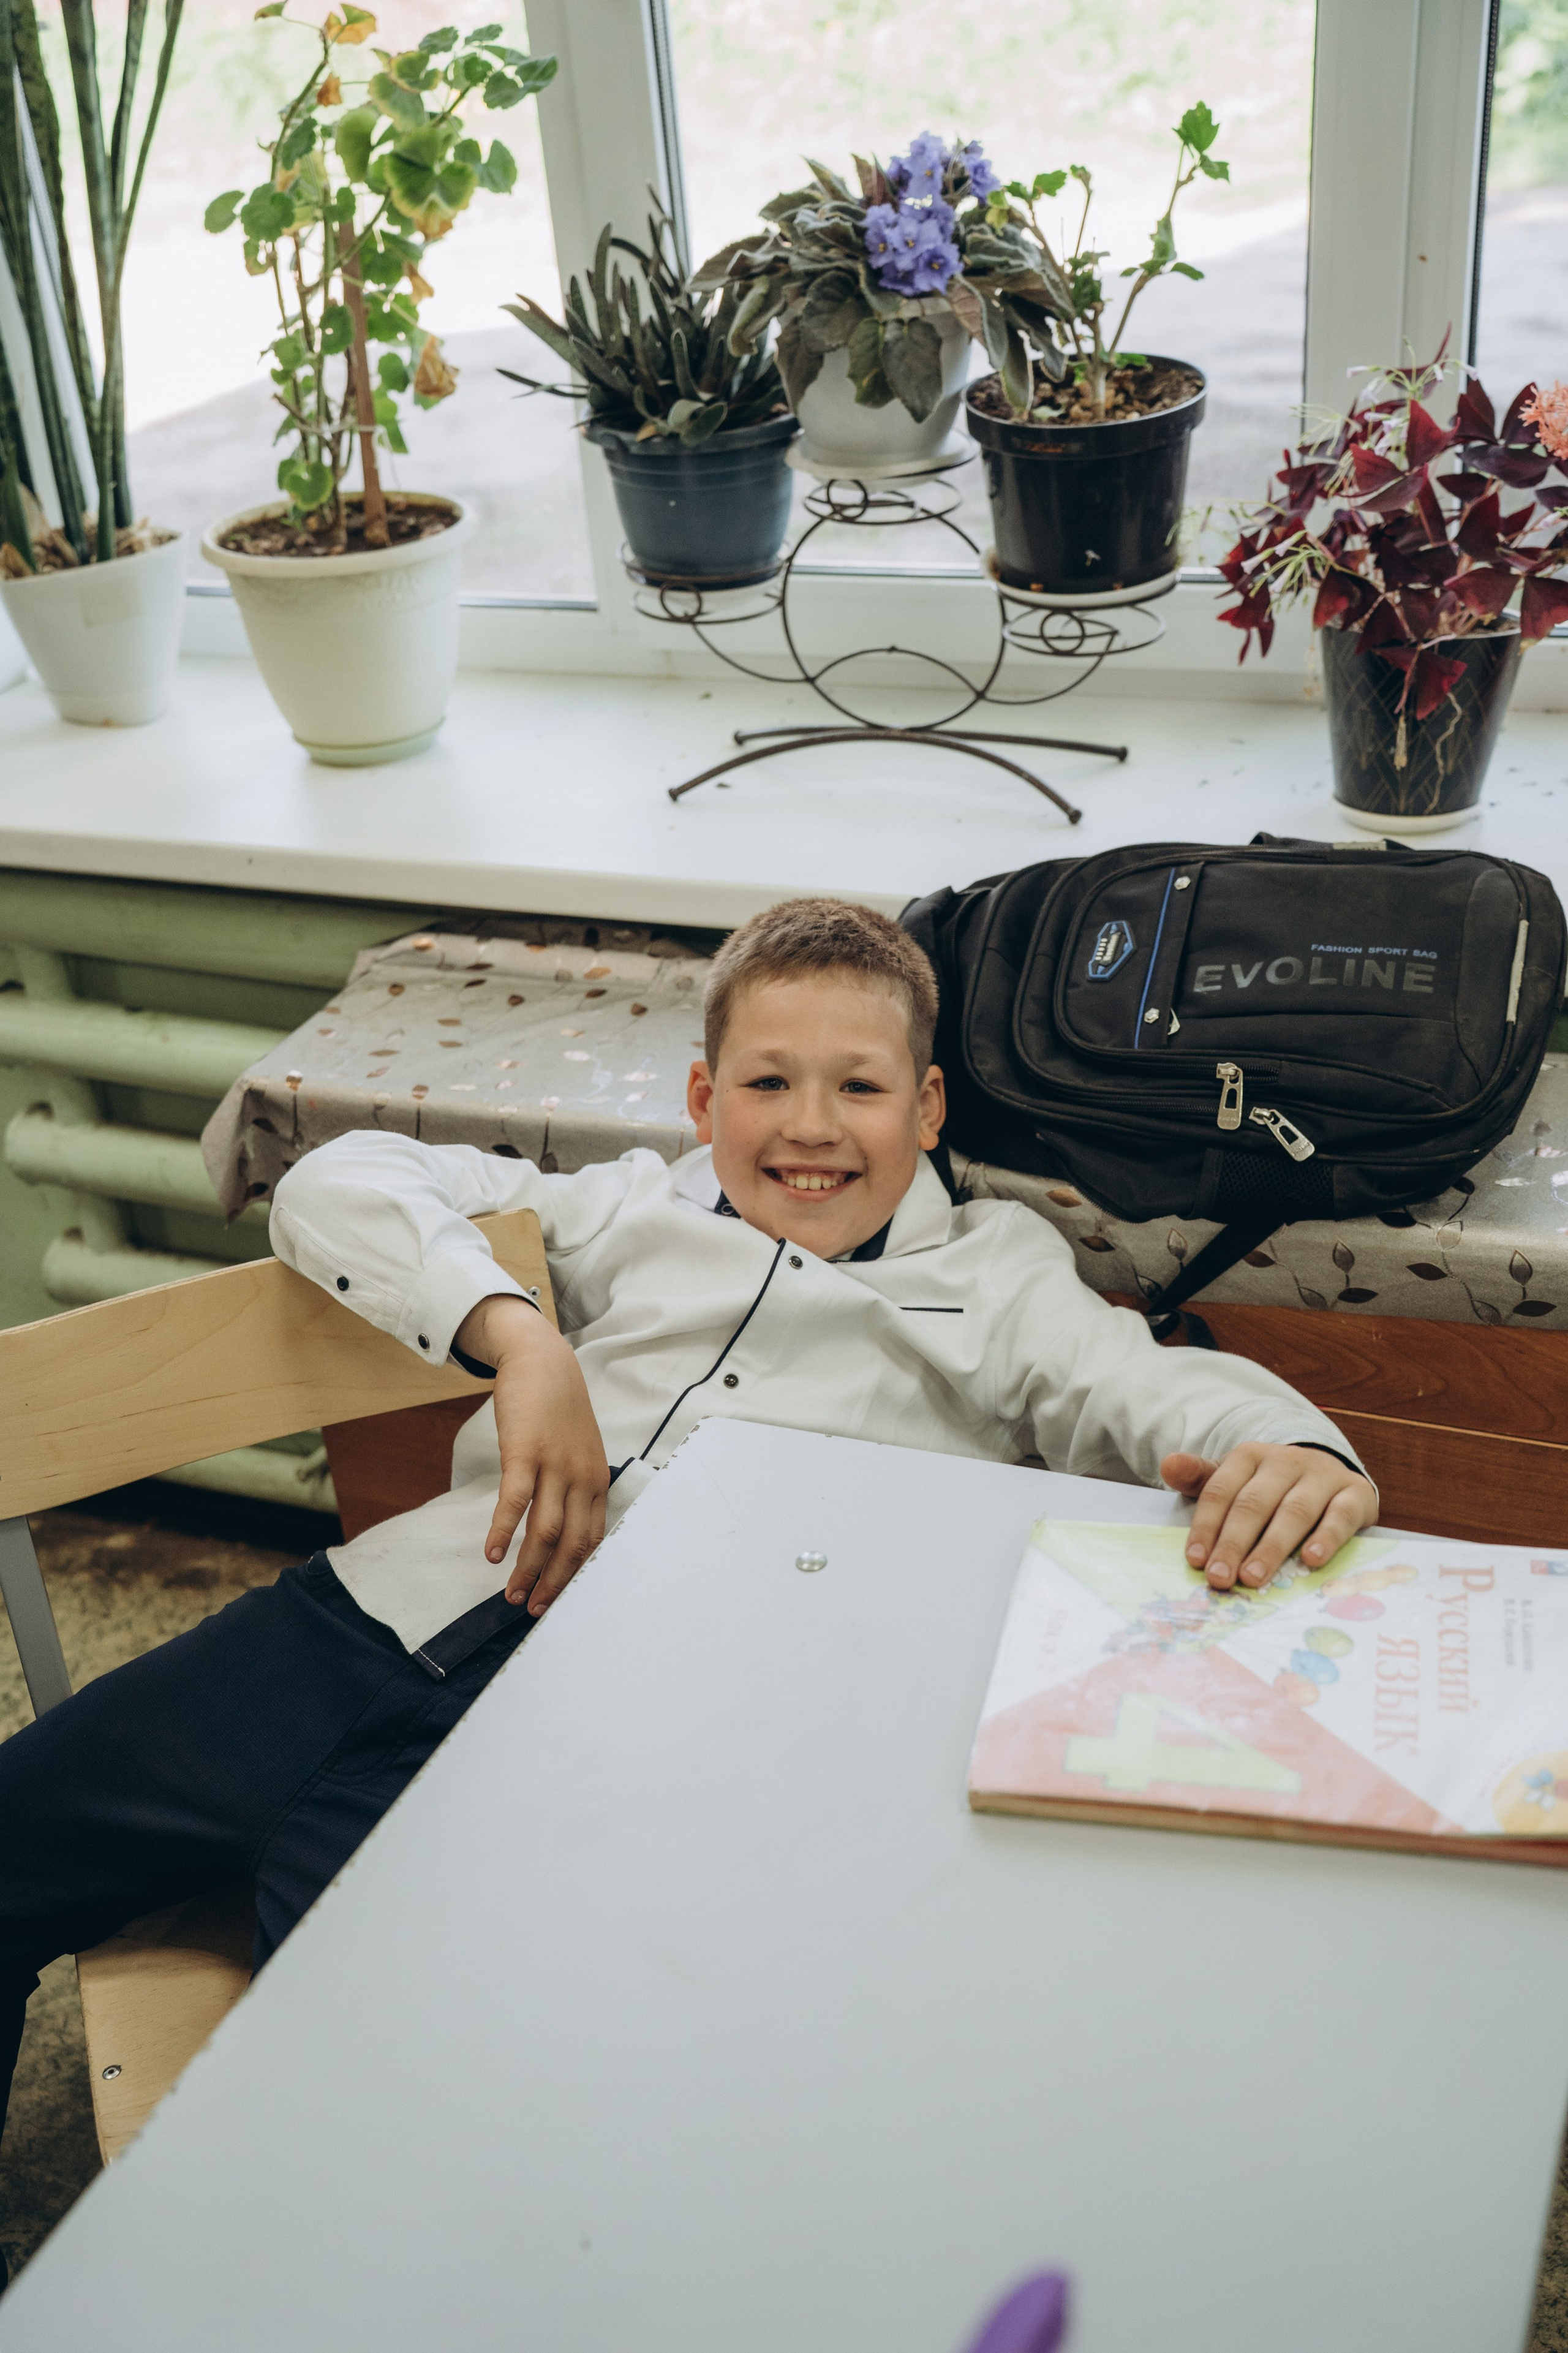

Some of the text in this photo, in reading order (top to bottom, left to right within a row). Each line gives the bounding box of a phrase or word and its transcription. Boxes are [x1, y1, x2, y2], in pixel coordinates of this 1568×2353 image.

[1193, 956, 1436, 994] EVOLINE
[1311, 943, 1438, 959] FASHION SPORT BAG
[1425, 1563, 1496, 1715] Русский
[1064, 1691, 1302, 1794] 4
